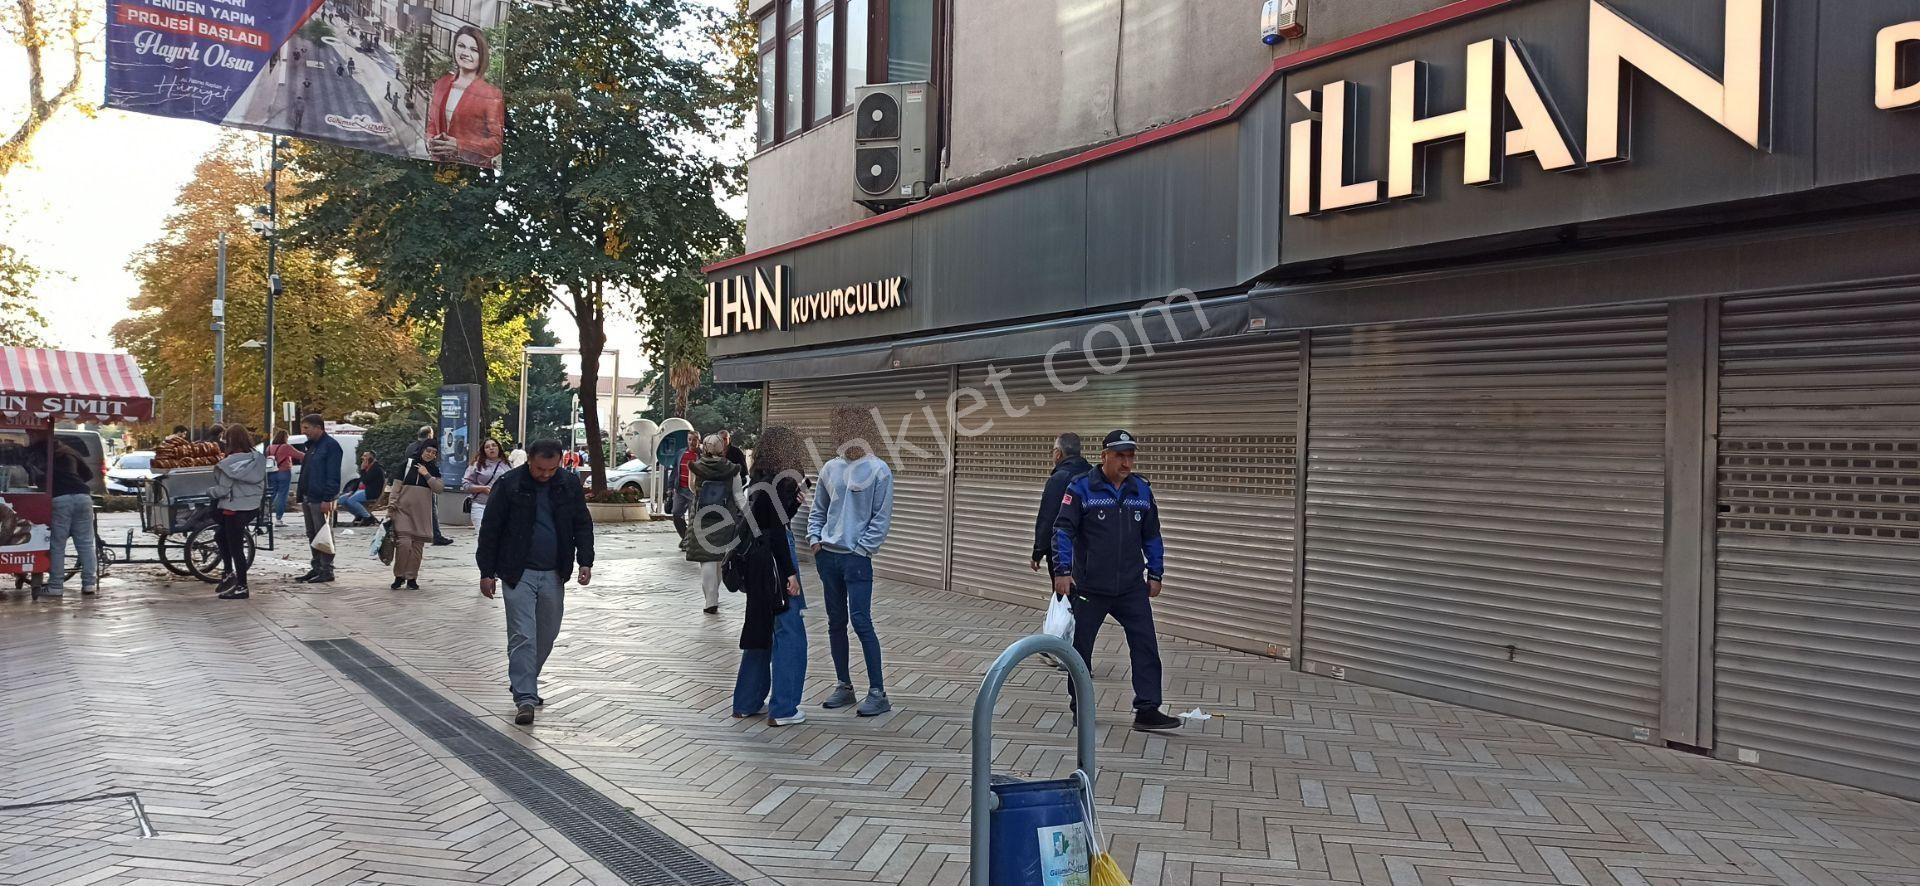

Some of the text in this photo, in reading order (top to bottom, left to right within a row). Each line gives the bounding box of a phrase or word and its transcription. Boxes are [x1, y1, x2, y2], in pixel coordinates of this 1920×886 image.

[127, 9, 262, 46] PROJESİ BAŞLADI
[210, 6, 255, 26] YAPIM
[134, 30, 254, 72] Hayırlı Olsun
[791, 276, 901, 325] KUYUMCULUK
[42, 394, 128, 415] SİMİT
[0, 553, 35, 565] Simit
